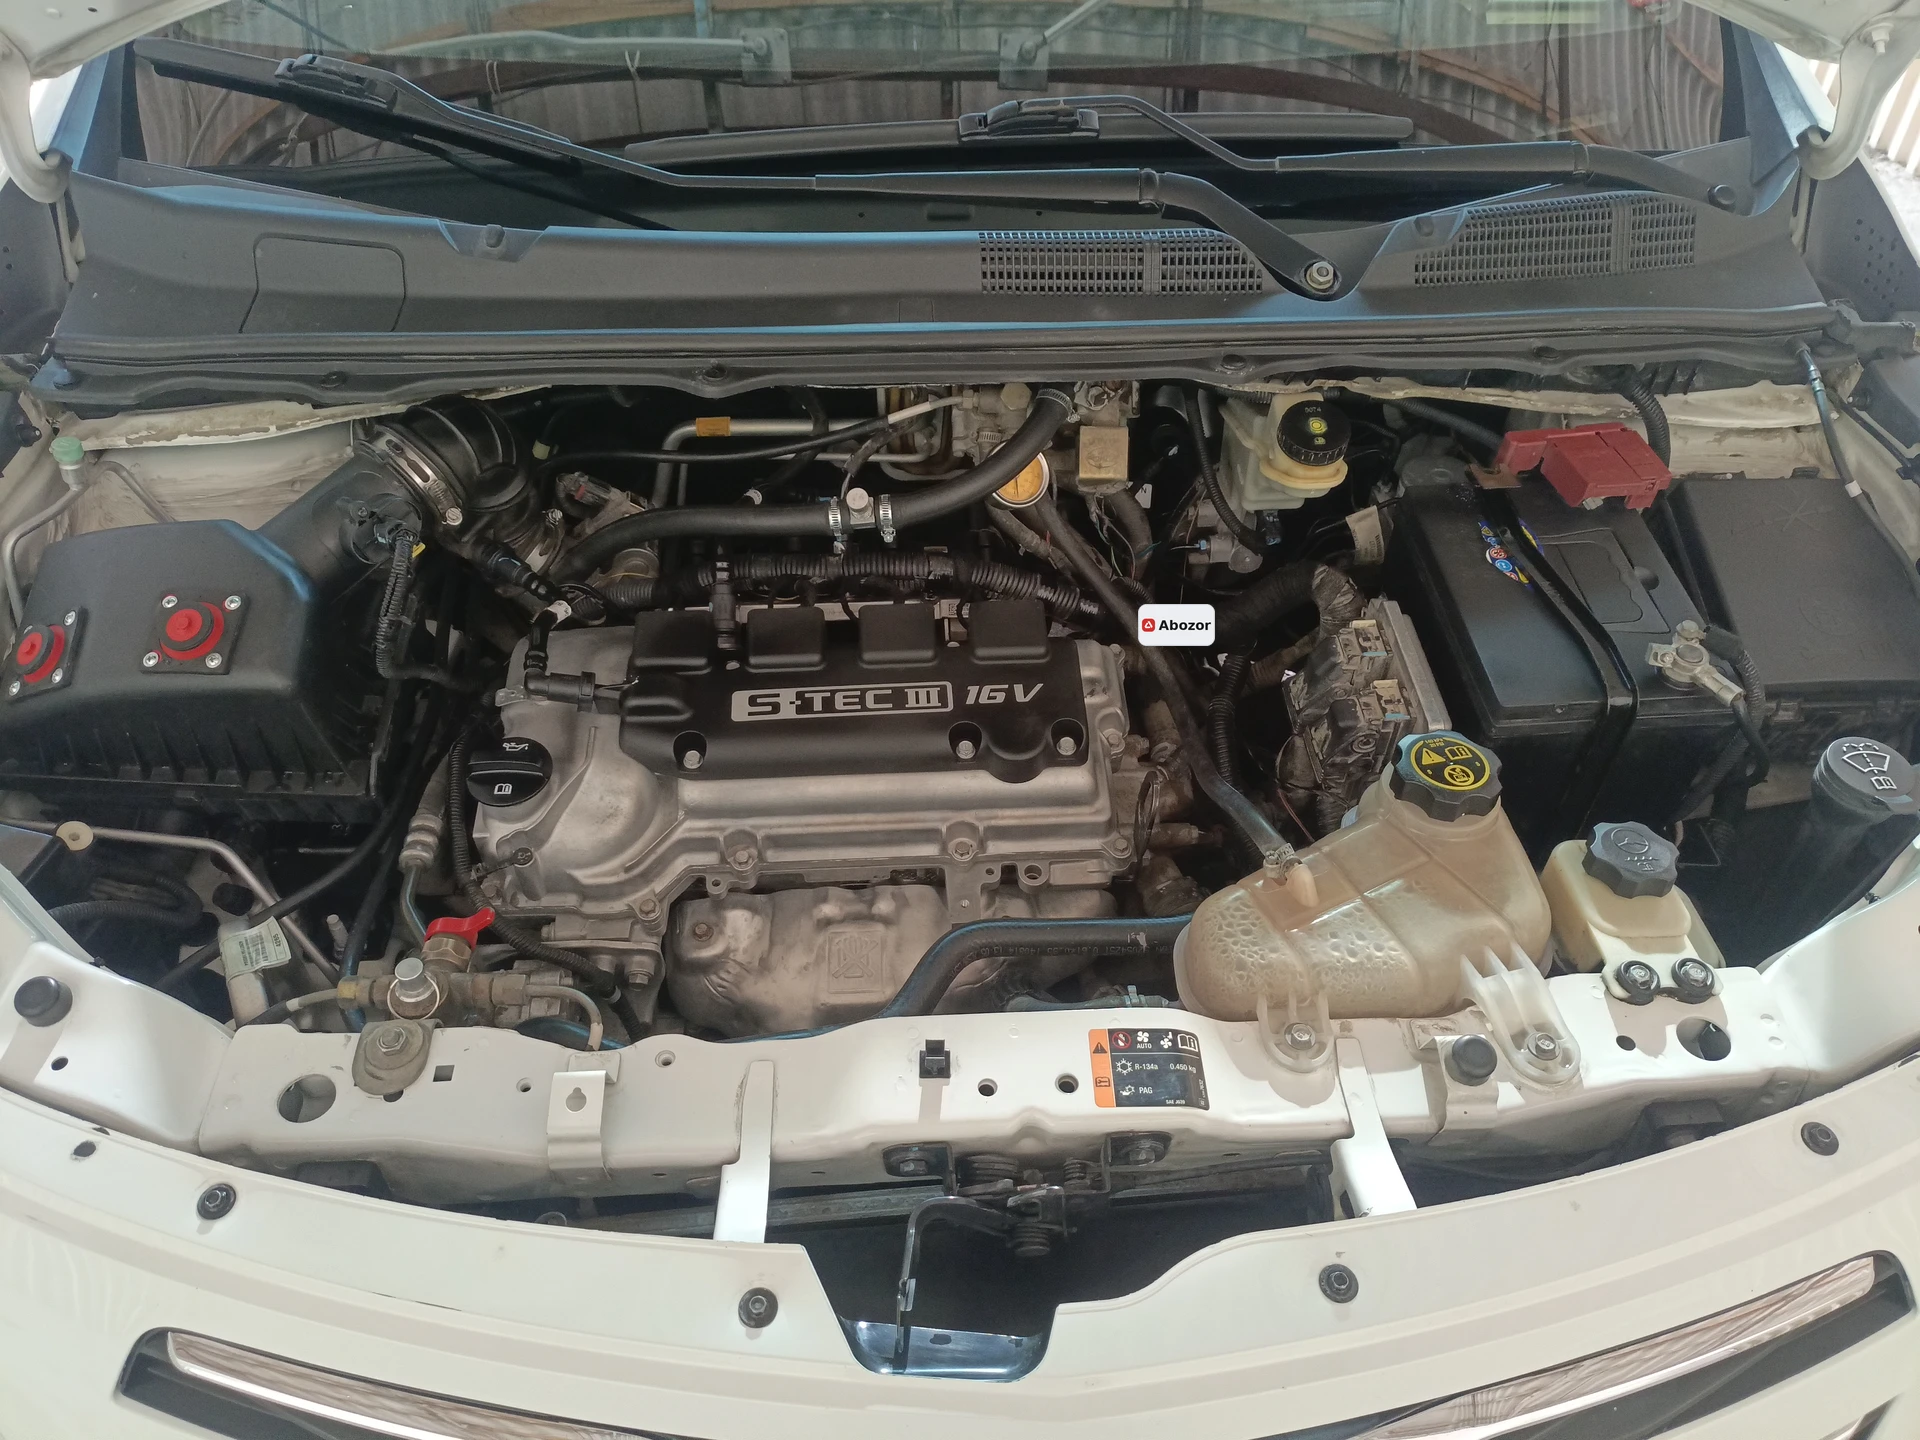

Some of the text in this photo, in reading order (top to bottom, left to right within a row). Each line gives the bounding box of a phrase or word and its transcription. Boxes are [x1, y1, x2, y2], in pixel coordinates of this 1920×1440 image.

[747, 688, 894, 717] S-TEC
[904, 687, 942, 708] III
[1169, 1063, 1188, 1071] 0.450
[1188, 1065, 1197, 1074] kg
[1138, 1086, 1153, 1094] PAG
